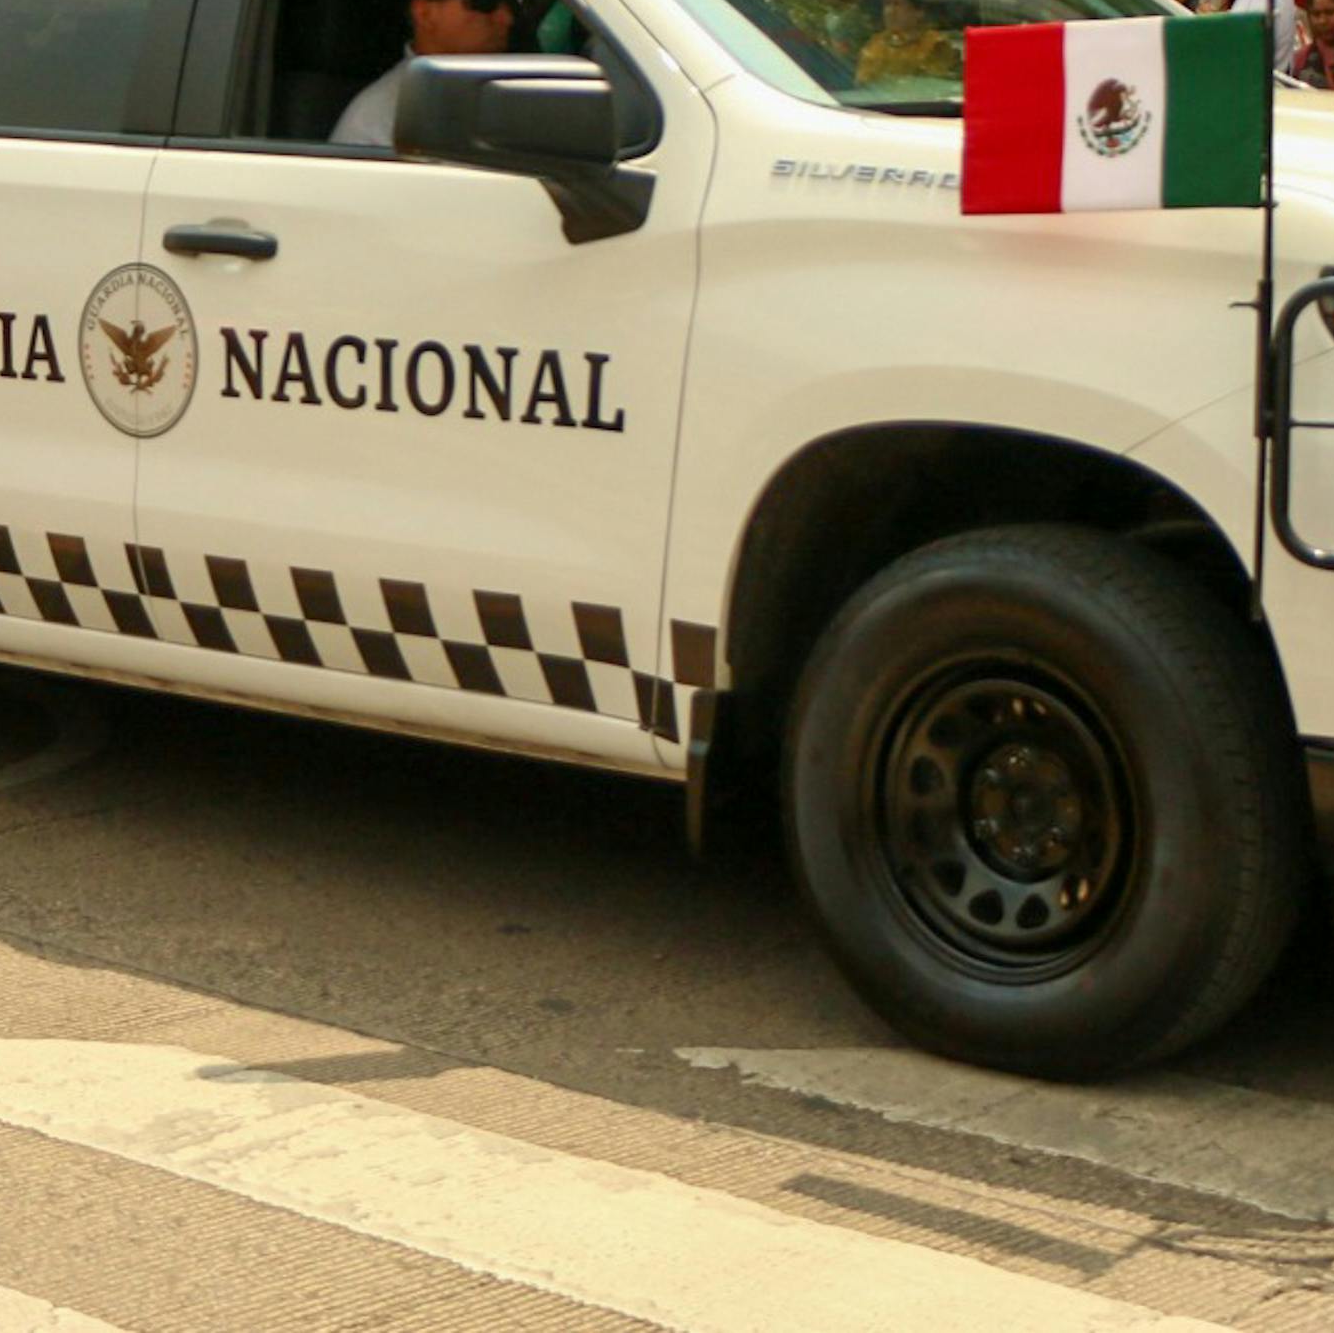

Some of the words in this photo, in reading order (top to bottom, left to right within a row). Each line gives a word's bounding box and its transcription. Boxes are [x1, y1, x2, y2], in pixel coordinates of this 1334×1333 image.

[771, 159, 961, 189] SILVERAD
[87, 272, 134, 331] GUARDIA
[138, 272, 189, 340] NACIONAL
[220, 328, 626, 433] NACIONAL
